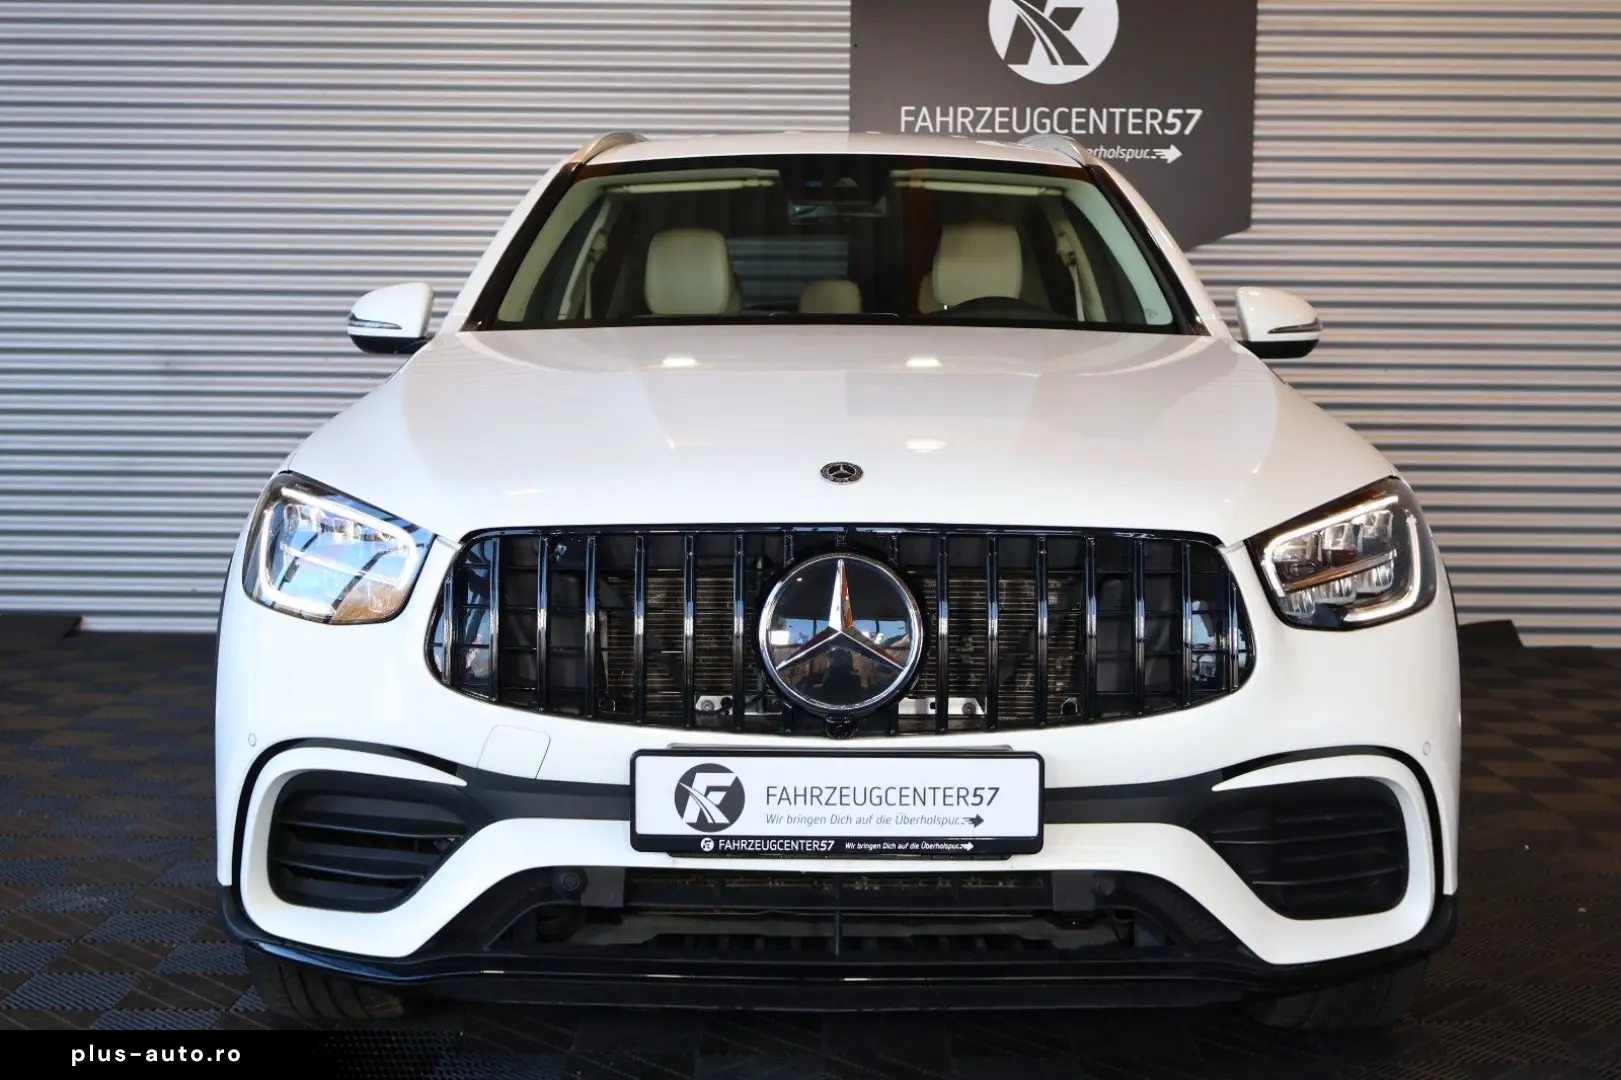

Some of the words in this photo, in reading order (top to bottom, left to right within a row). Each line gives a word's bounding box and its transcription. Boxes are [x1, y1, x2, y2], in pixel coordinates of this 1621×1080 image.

[900, 106, 1203, 136] FAHRZEUGCENTER57
[766, 786, 1000, 807] FAHRZEUGCENTER57
[766, 813, 784, 825] Wir
[786, 814, 827, 828] bringen
[829, 814, 853, 825] Dich
[855, 814, 874, 825] auf
[875, 814, 892, 825] die
[718, 839, 835, 851] FAHRZEUGCENTER57
[845, 842, 855, 850] Wir
[857, 842, 881, 851] bringen
[882, 842, 897, 850] Dich
[897, 842, 908, 850] auf
[910, 842, 920, 850] die
